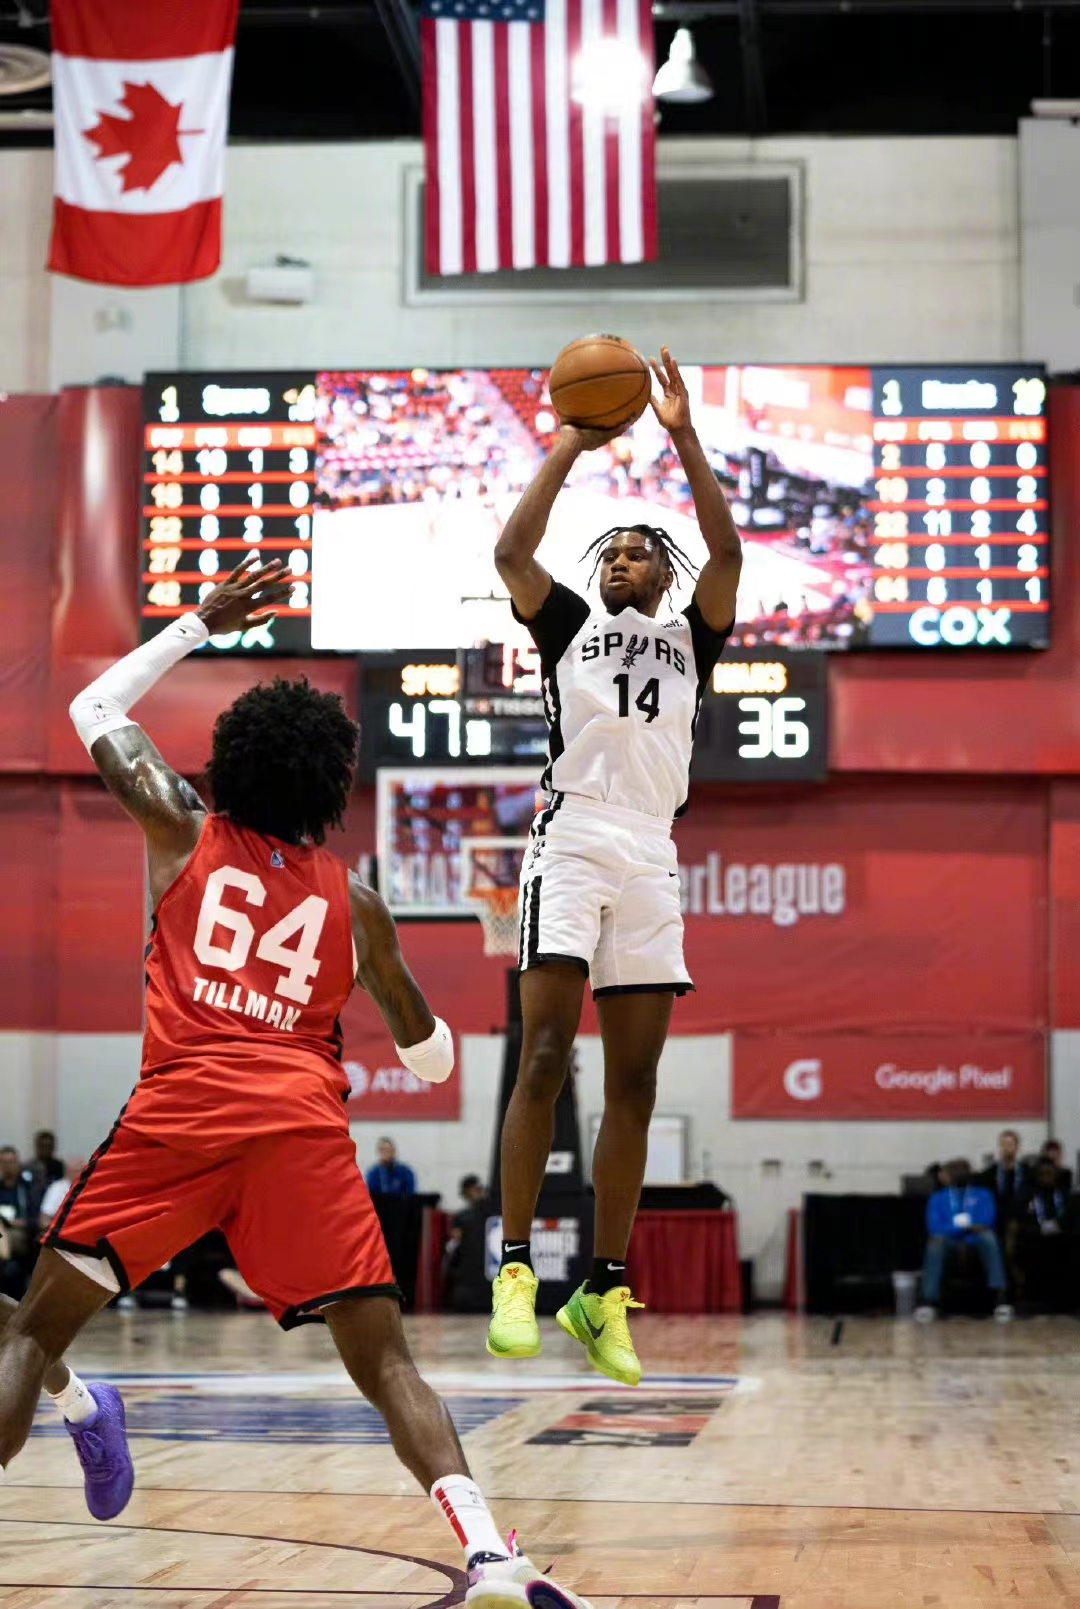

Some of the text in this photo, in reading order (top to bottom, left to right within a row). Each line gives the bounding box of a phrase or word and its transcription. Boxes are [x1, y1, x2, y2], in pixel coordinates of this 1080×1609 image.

[248, 448, 263, 474] 1
[248, 483, 263, 509] 1
[295, 514, 310, 541] 1
[923, 510, 951, 536] 11
[1016, 509, 1037, 535] 4
[975, 544, 990, 570] 1
[976, 578, 992, 605] 1
[1025, 576, 1040, 604] 1
[909, 607, 1011, 645] COX
[581, 632, 686, 676] SPURS
[613, 673, 660, 723] 14
[389, 700, 461, 757] 47
[738, 697, 809, 758] 36
[193, 865, 328, 1005] 64
[193, 976, 301, 1032] TILLMAN
[784, 1059, 822, 1101] G
[875, 1063, 1013, 1096] Google Pixel
